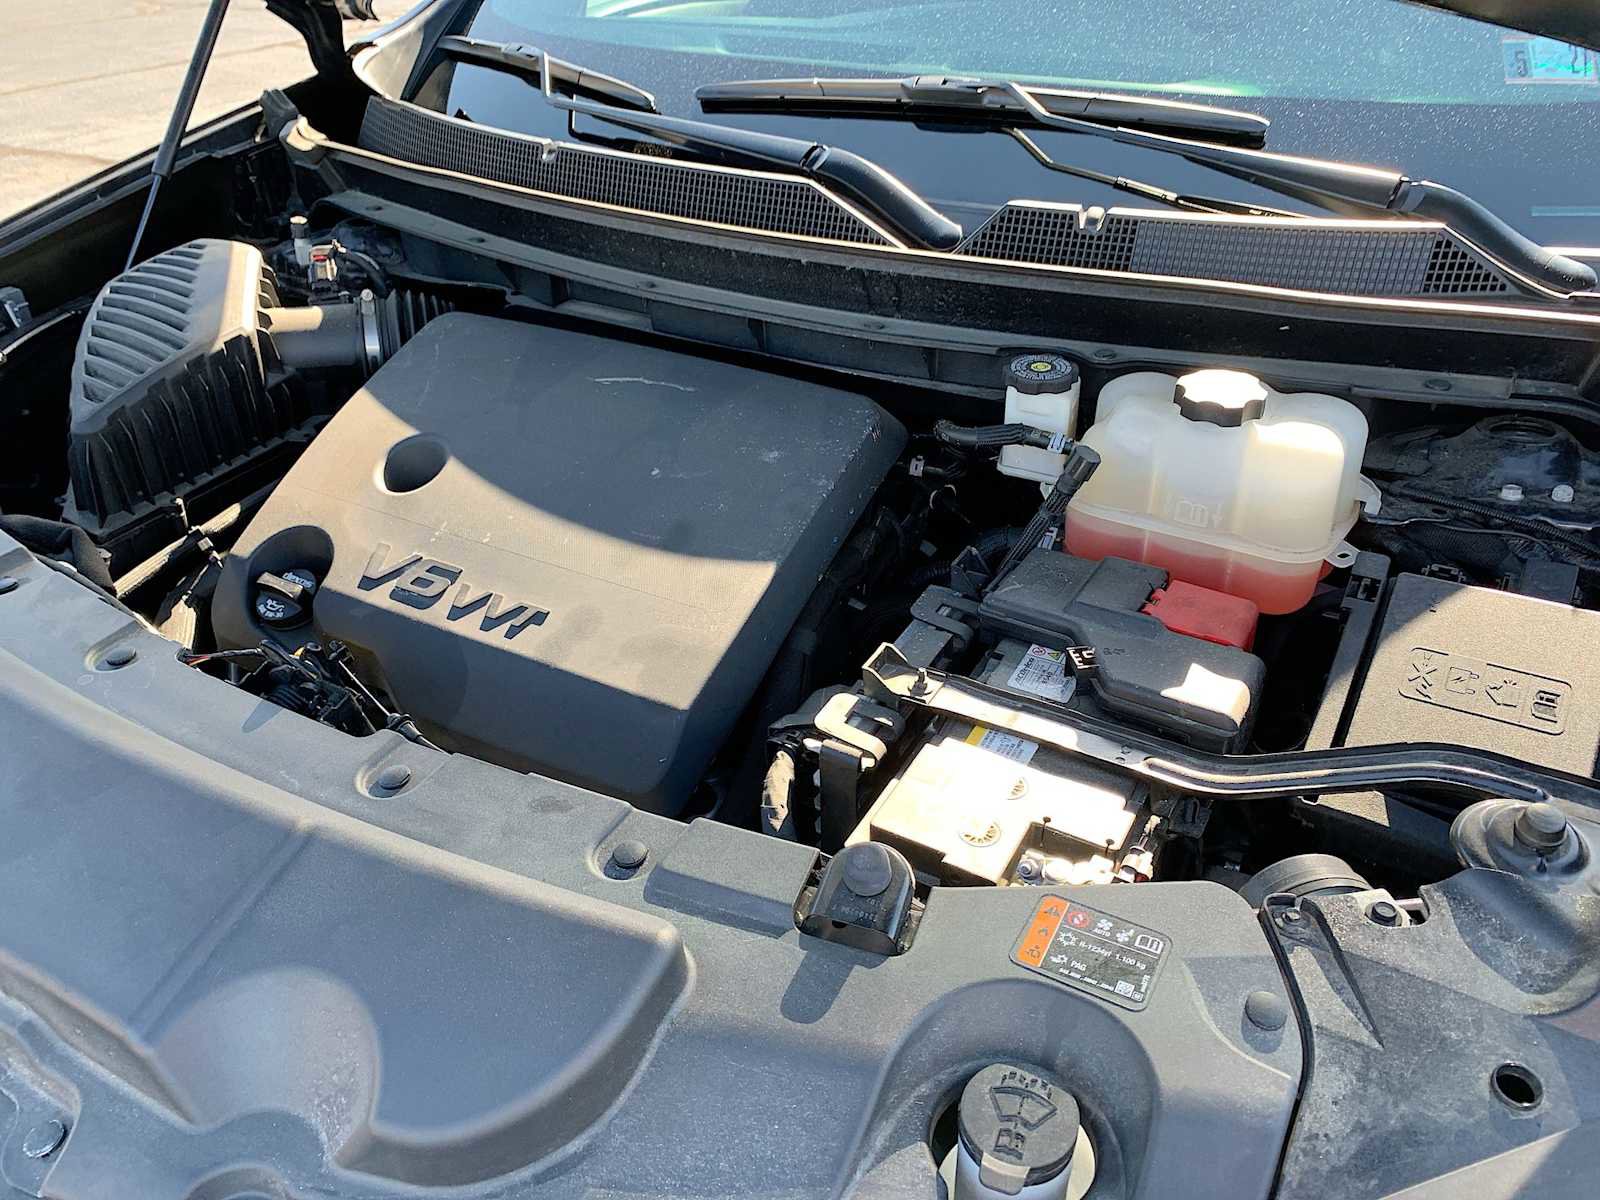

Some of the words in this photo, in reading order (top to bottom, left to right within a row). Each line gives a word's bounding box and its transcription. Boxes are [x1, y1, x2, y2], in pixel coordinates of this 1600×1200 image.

[281, 571, 314, 589] dexos
[357, 541, 464, 610] V6
[446, 583, 551, 640] VVT
[1092, 928, 1111, 937] AUTO
[1070, 960, 1087, 972] PAG
[1136, 961, 1147, 971] kg
